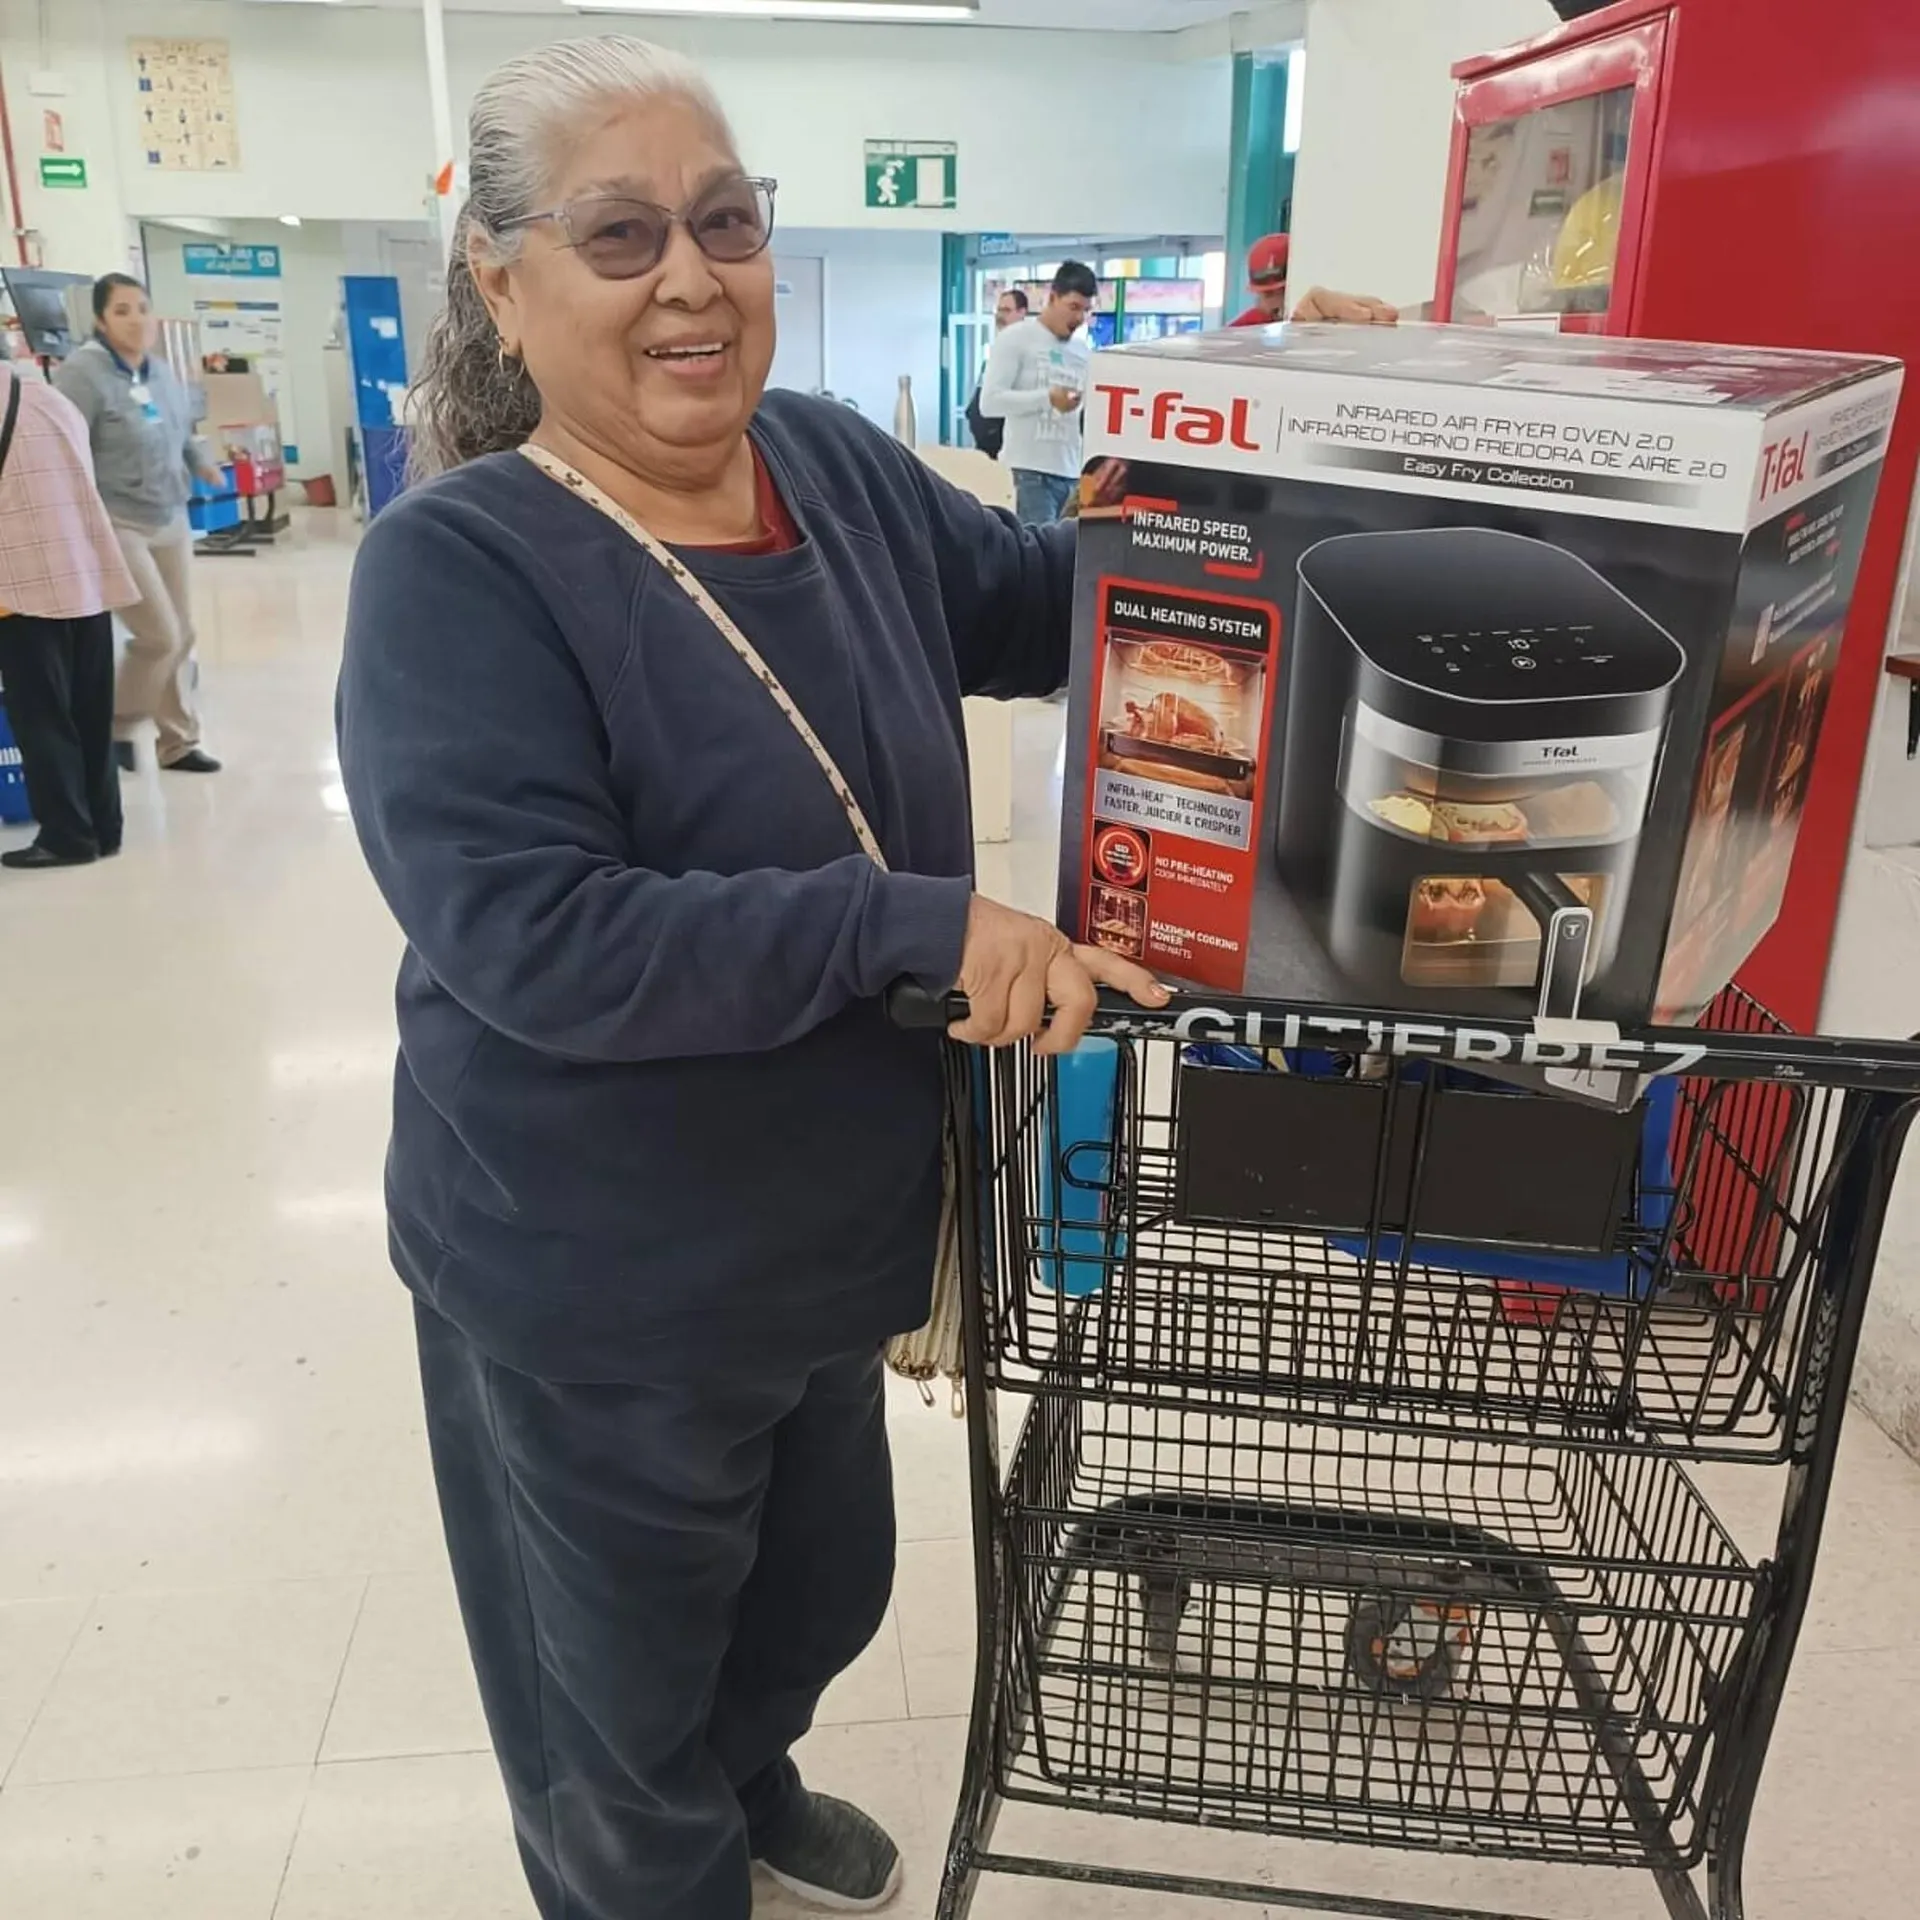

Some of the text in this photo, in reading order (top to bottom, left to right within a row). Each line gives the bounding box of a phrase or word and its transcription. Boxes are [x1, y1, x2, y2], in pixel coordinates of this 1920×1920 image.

[1095, 384, 1260, 450] T-fal
[1336, 403, 1673, 452] INFRARED AIR FRYER OVEN 2.0
[1288, 418, 1728, 479] INFRARED HORNO FREIDORA DE AIRE 2.0
[1403, 457, 1574, 490] Easy Fry Collection
[1760, 430, 1808, 502] T-fal
[1133, 511, 1252, 543] INFRARED SPEED,
[1132, 531, 1253, 562] MAXIMUM POWER.
[1114, 600, 1263, 639] DUAL HEATING SYSTEM
[1104, 796, 1242, 837] FASTER, JUICIER & CRISPIER
[1176, 796, 1241, 820] TECHNOLOGY
[1155, 856, 1235, 884] NO PRE-HEATING
[1150, 930, 1184, 946] POWER
[1151, 920, 1239, 952] MAXIMUM COOKING
